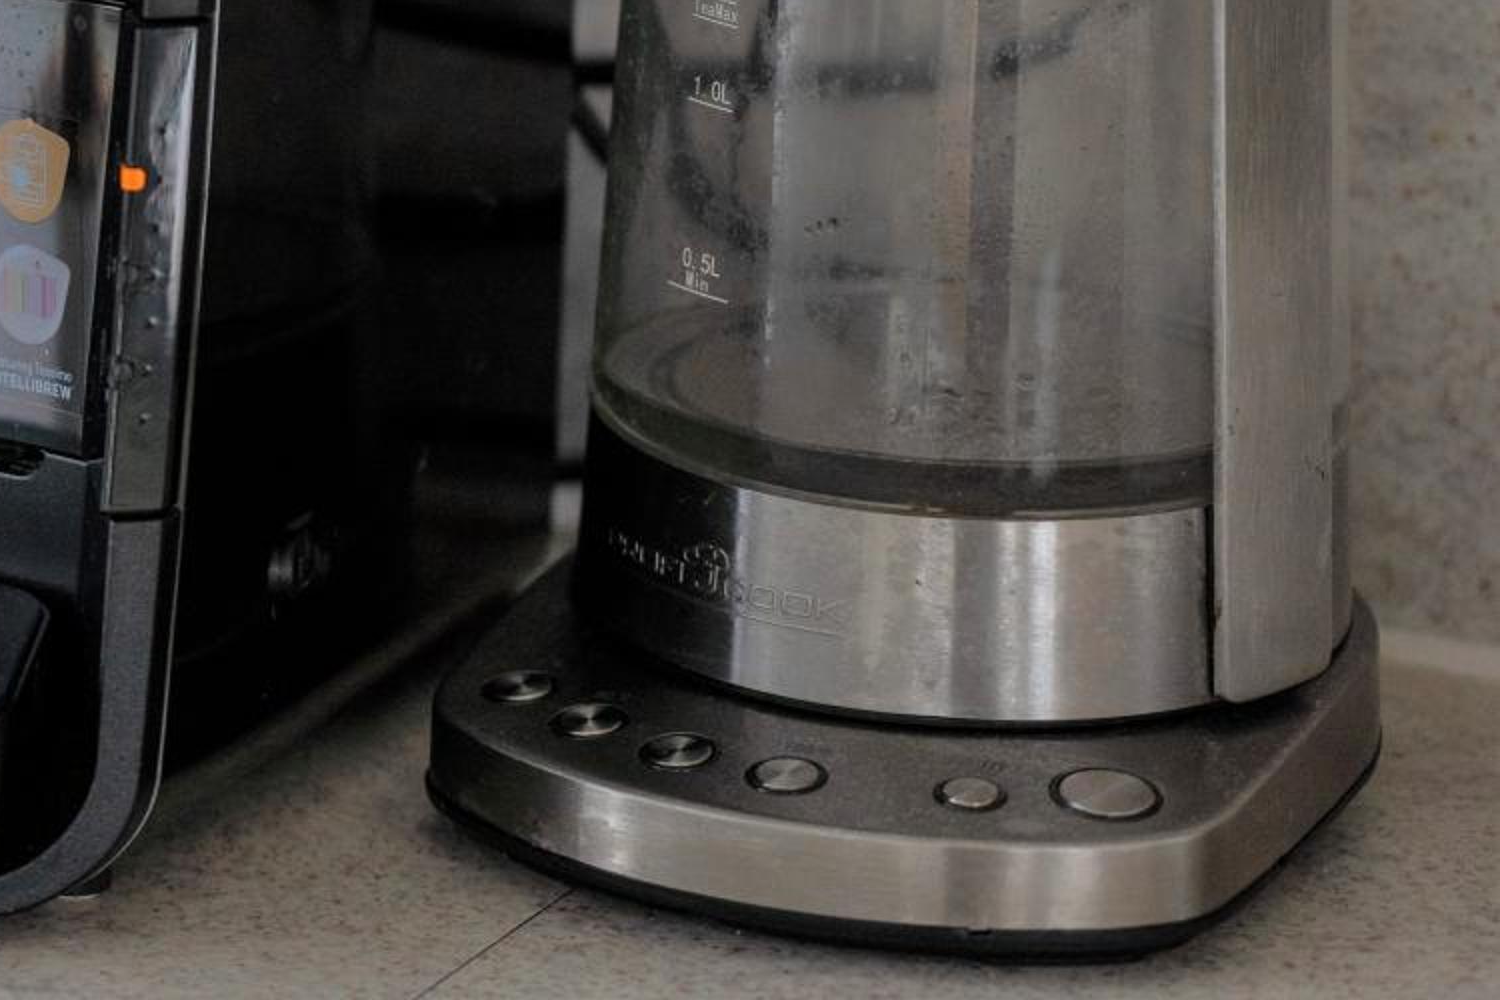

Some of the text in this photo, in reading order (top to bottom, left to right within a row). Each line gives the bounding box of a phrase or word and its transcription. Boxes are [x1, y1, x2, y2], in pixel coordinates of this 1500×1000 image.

[693, 75, 732, 104] 1.0L
[681, 247, 721, 279] 0.5L
[684, 268, 709, 293] Min
